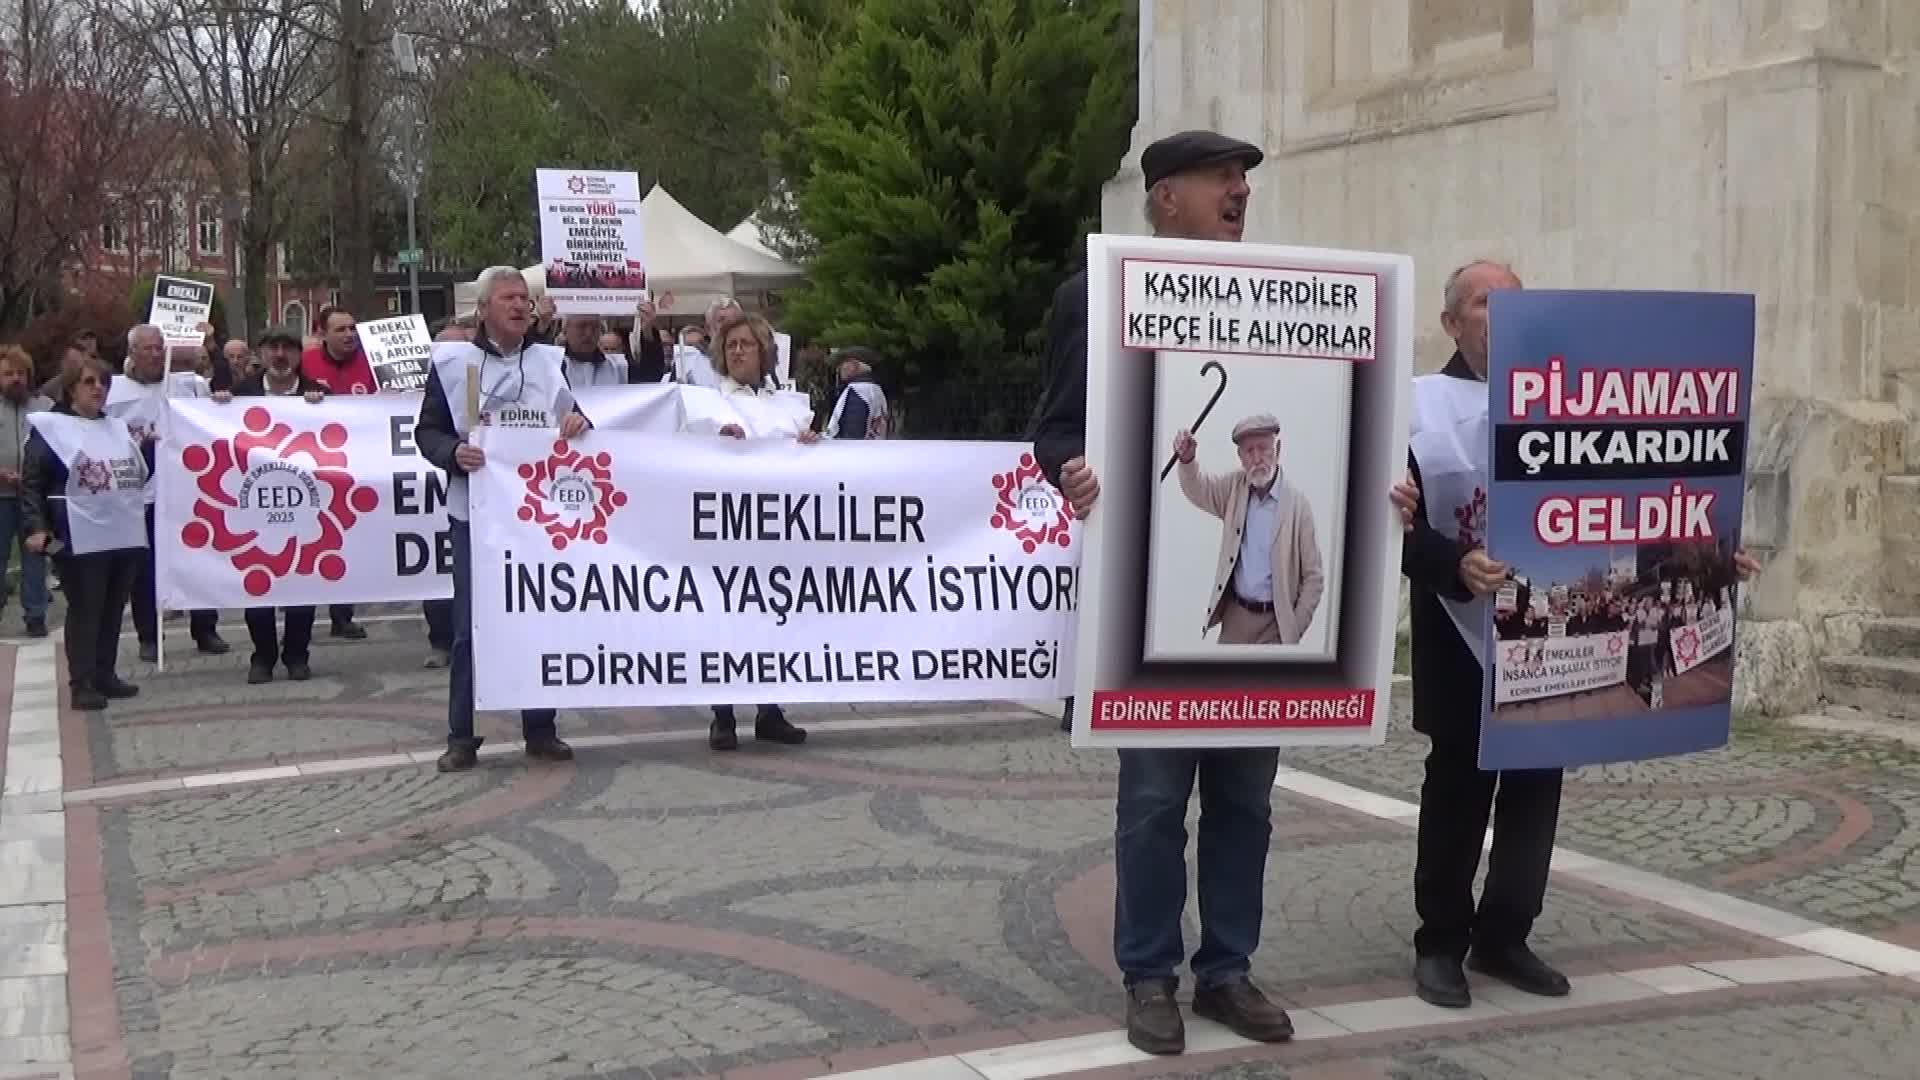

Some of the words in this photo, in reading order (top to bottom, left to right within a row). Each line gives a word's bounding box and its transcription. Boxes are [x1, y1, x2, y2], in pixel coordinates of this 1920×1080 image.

[586, 200, 616, 216] YÜKÜ
[1144, 272, 1242, 303] KAŞIKLA
[1249, 276, 1358, 308] VERDİLER
[368, 317, 416, 336] EMEKLİ
[1128, 312, 1201, 344] KEPÇE
[1209, 312, 1240, 343] İLE
[1247, 319, 1372, 350] ALIYORLAR
[387, 343, 431, 359] ARIYOR
[1511, 359, 1739, 417] PİJAMAYI
[501, 407, 548, 422] EDİRNE
[1518, 428, 1731, 475] ÇIKARDIK
[257, 486, 304, 509] EED
[559, 489, 586, 503] EED
[266, 511, 296, 523] 2025
[693, 482, 926, 543] EMEKLİLER
[1536, 484, 1714, 544] GELDİK
[504, 549, 705, 614] İNSANCA
[712, 564, 918, 627] YAŞAMAK
[926, 553, 1080, 613] İSTİYOR!
[541, 643, 688, 687] EDİRNE
[700, 643, 901, 684] EMEKLİLER
[912, 639, 1059, 681] DERNEĞİ
[1100, 695, 1175, 722] EDİRNE
[1178, 695, 1282, 721] EMEKLİLER
[1286, 693, 1366, 720] DERNEĞİ
